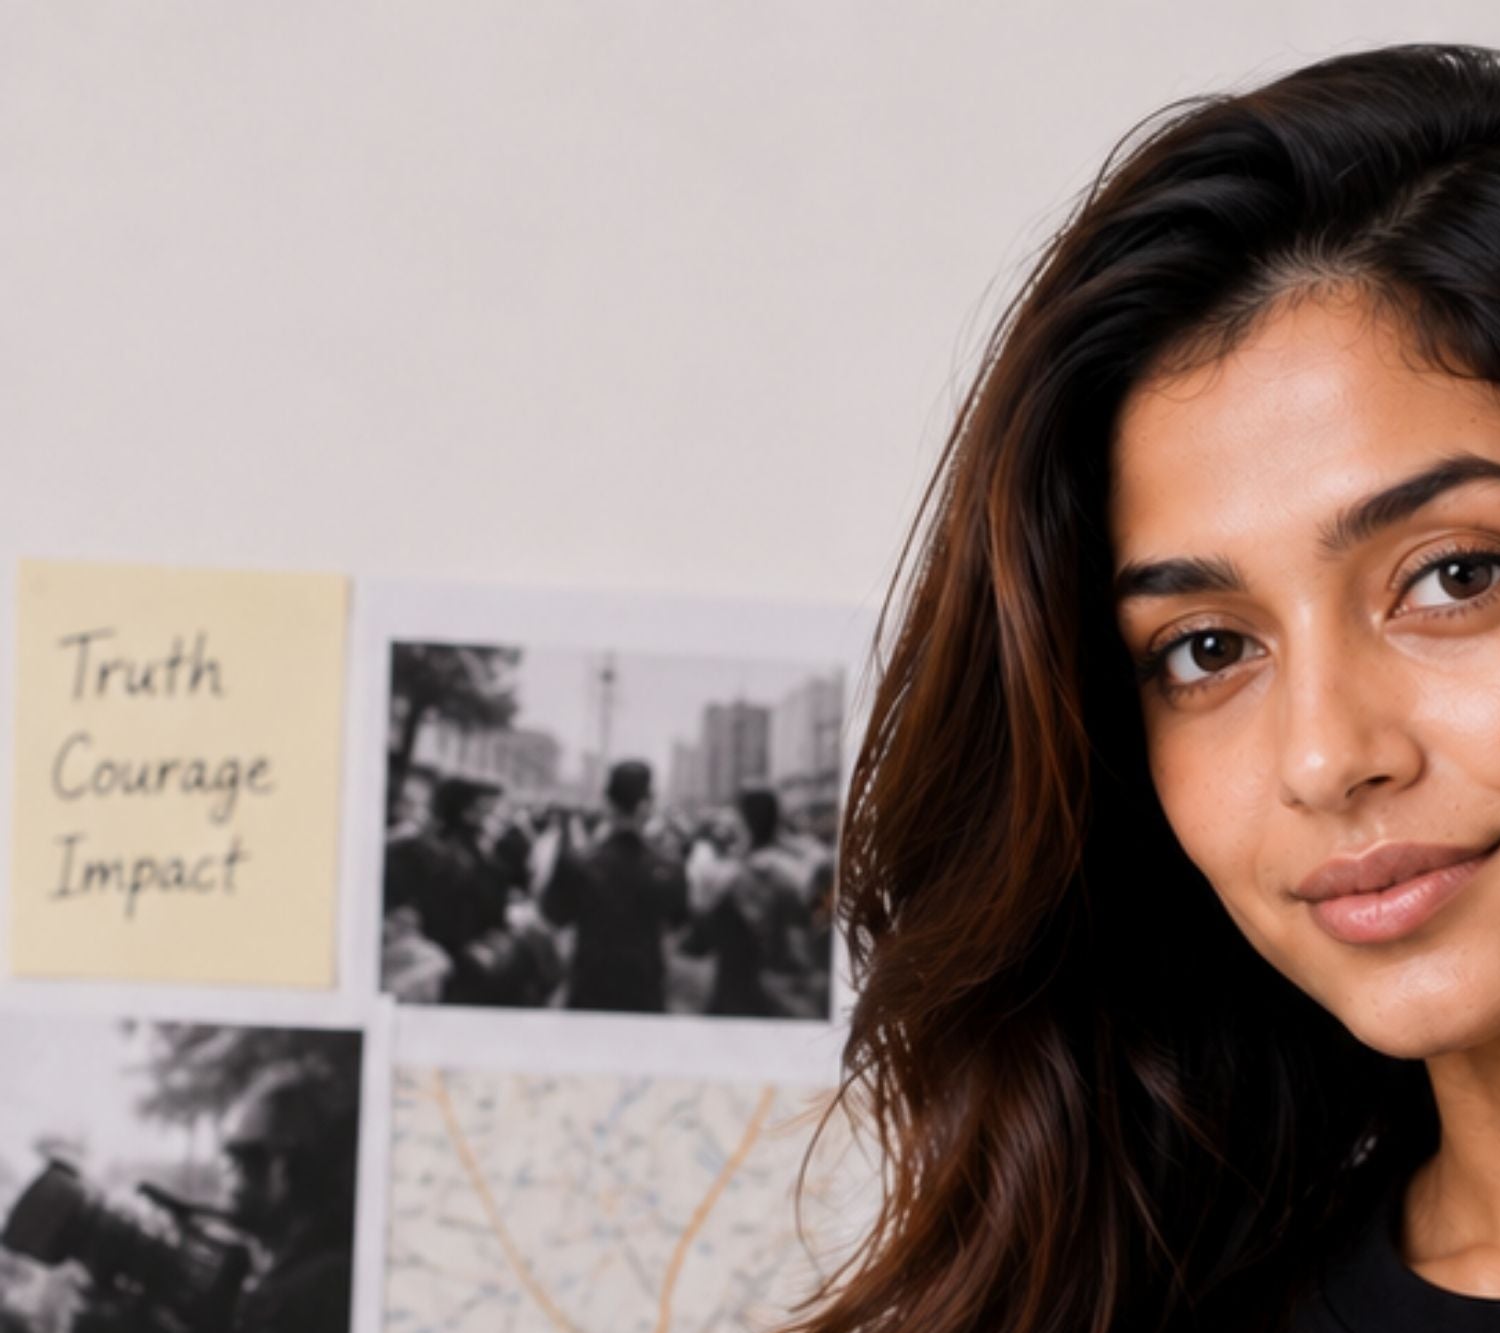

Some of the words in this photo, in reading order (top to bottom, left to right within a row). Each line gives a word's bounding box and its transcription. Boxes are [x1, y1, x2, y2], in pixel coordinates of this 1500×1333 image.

[57, 628, 225, 701] Truth
[51, 731, 278, 826] Courage
[49, 833, 251, 921] Impact
